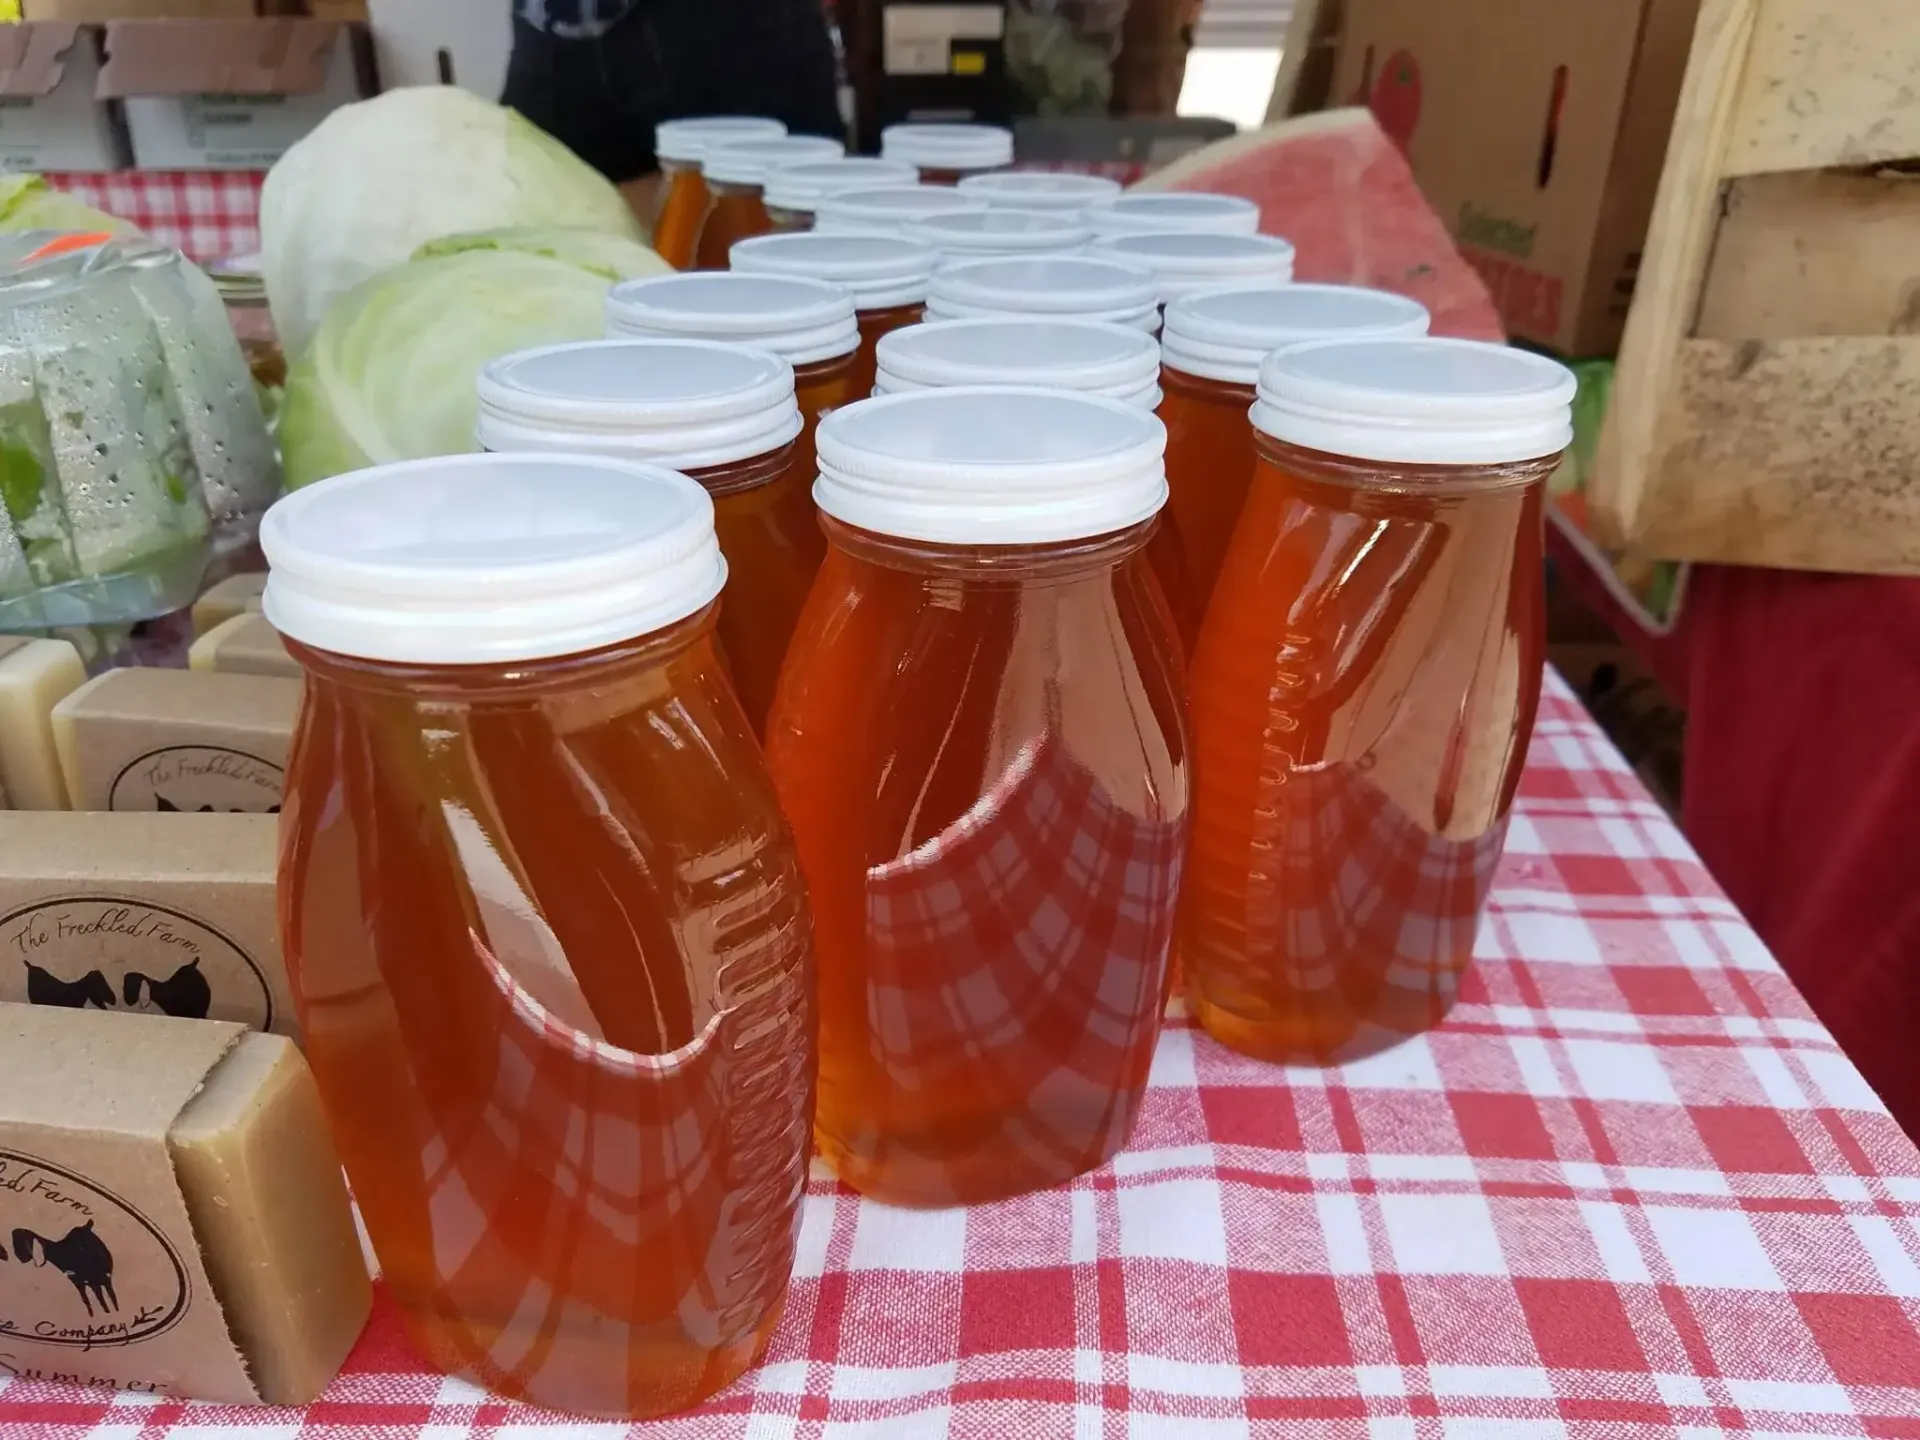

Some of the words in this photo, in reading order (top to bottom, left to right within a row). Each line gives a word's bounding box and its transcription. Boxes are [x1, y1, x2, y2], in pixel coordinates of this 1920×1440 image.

[144, 755, 172, 786] The
[177, 755, 249, 780] Freckled
[10, 912, 49, 953] The
[56, 907, 152, 938] Freckled
[147, 920, 201, 953] Farm
[30, 1177, 94, 1215] Farm
[34, 1320, 129, 1352] Company
